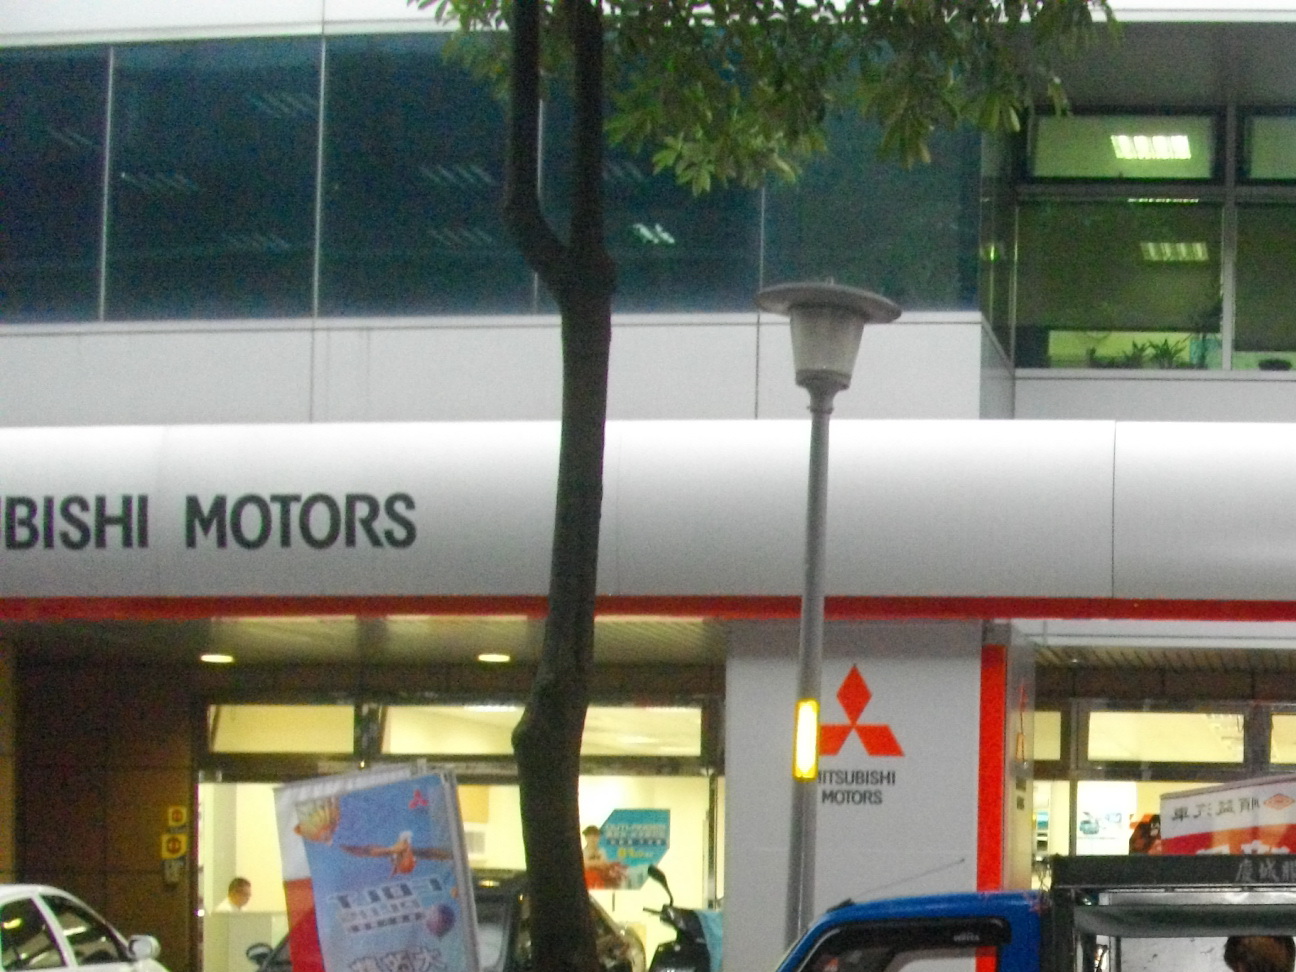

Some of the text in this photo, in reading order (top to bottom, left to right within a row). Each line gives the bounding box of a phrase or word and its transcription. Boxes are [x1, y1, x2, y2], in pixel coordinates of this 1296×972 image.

[0, 492, 418, 550] BISHI MOTORS
[821, 789, 884, 805] MOTORS
